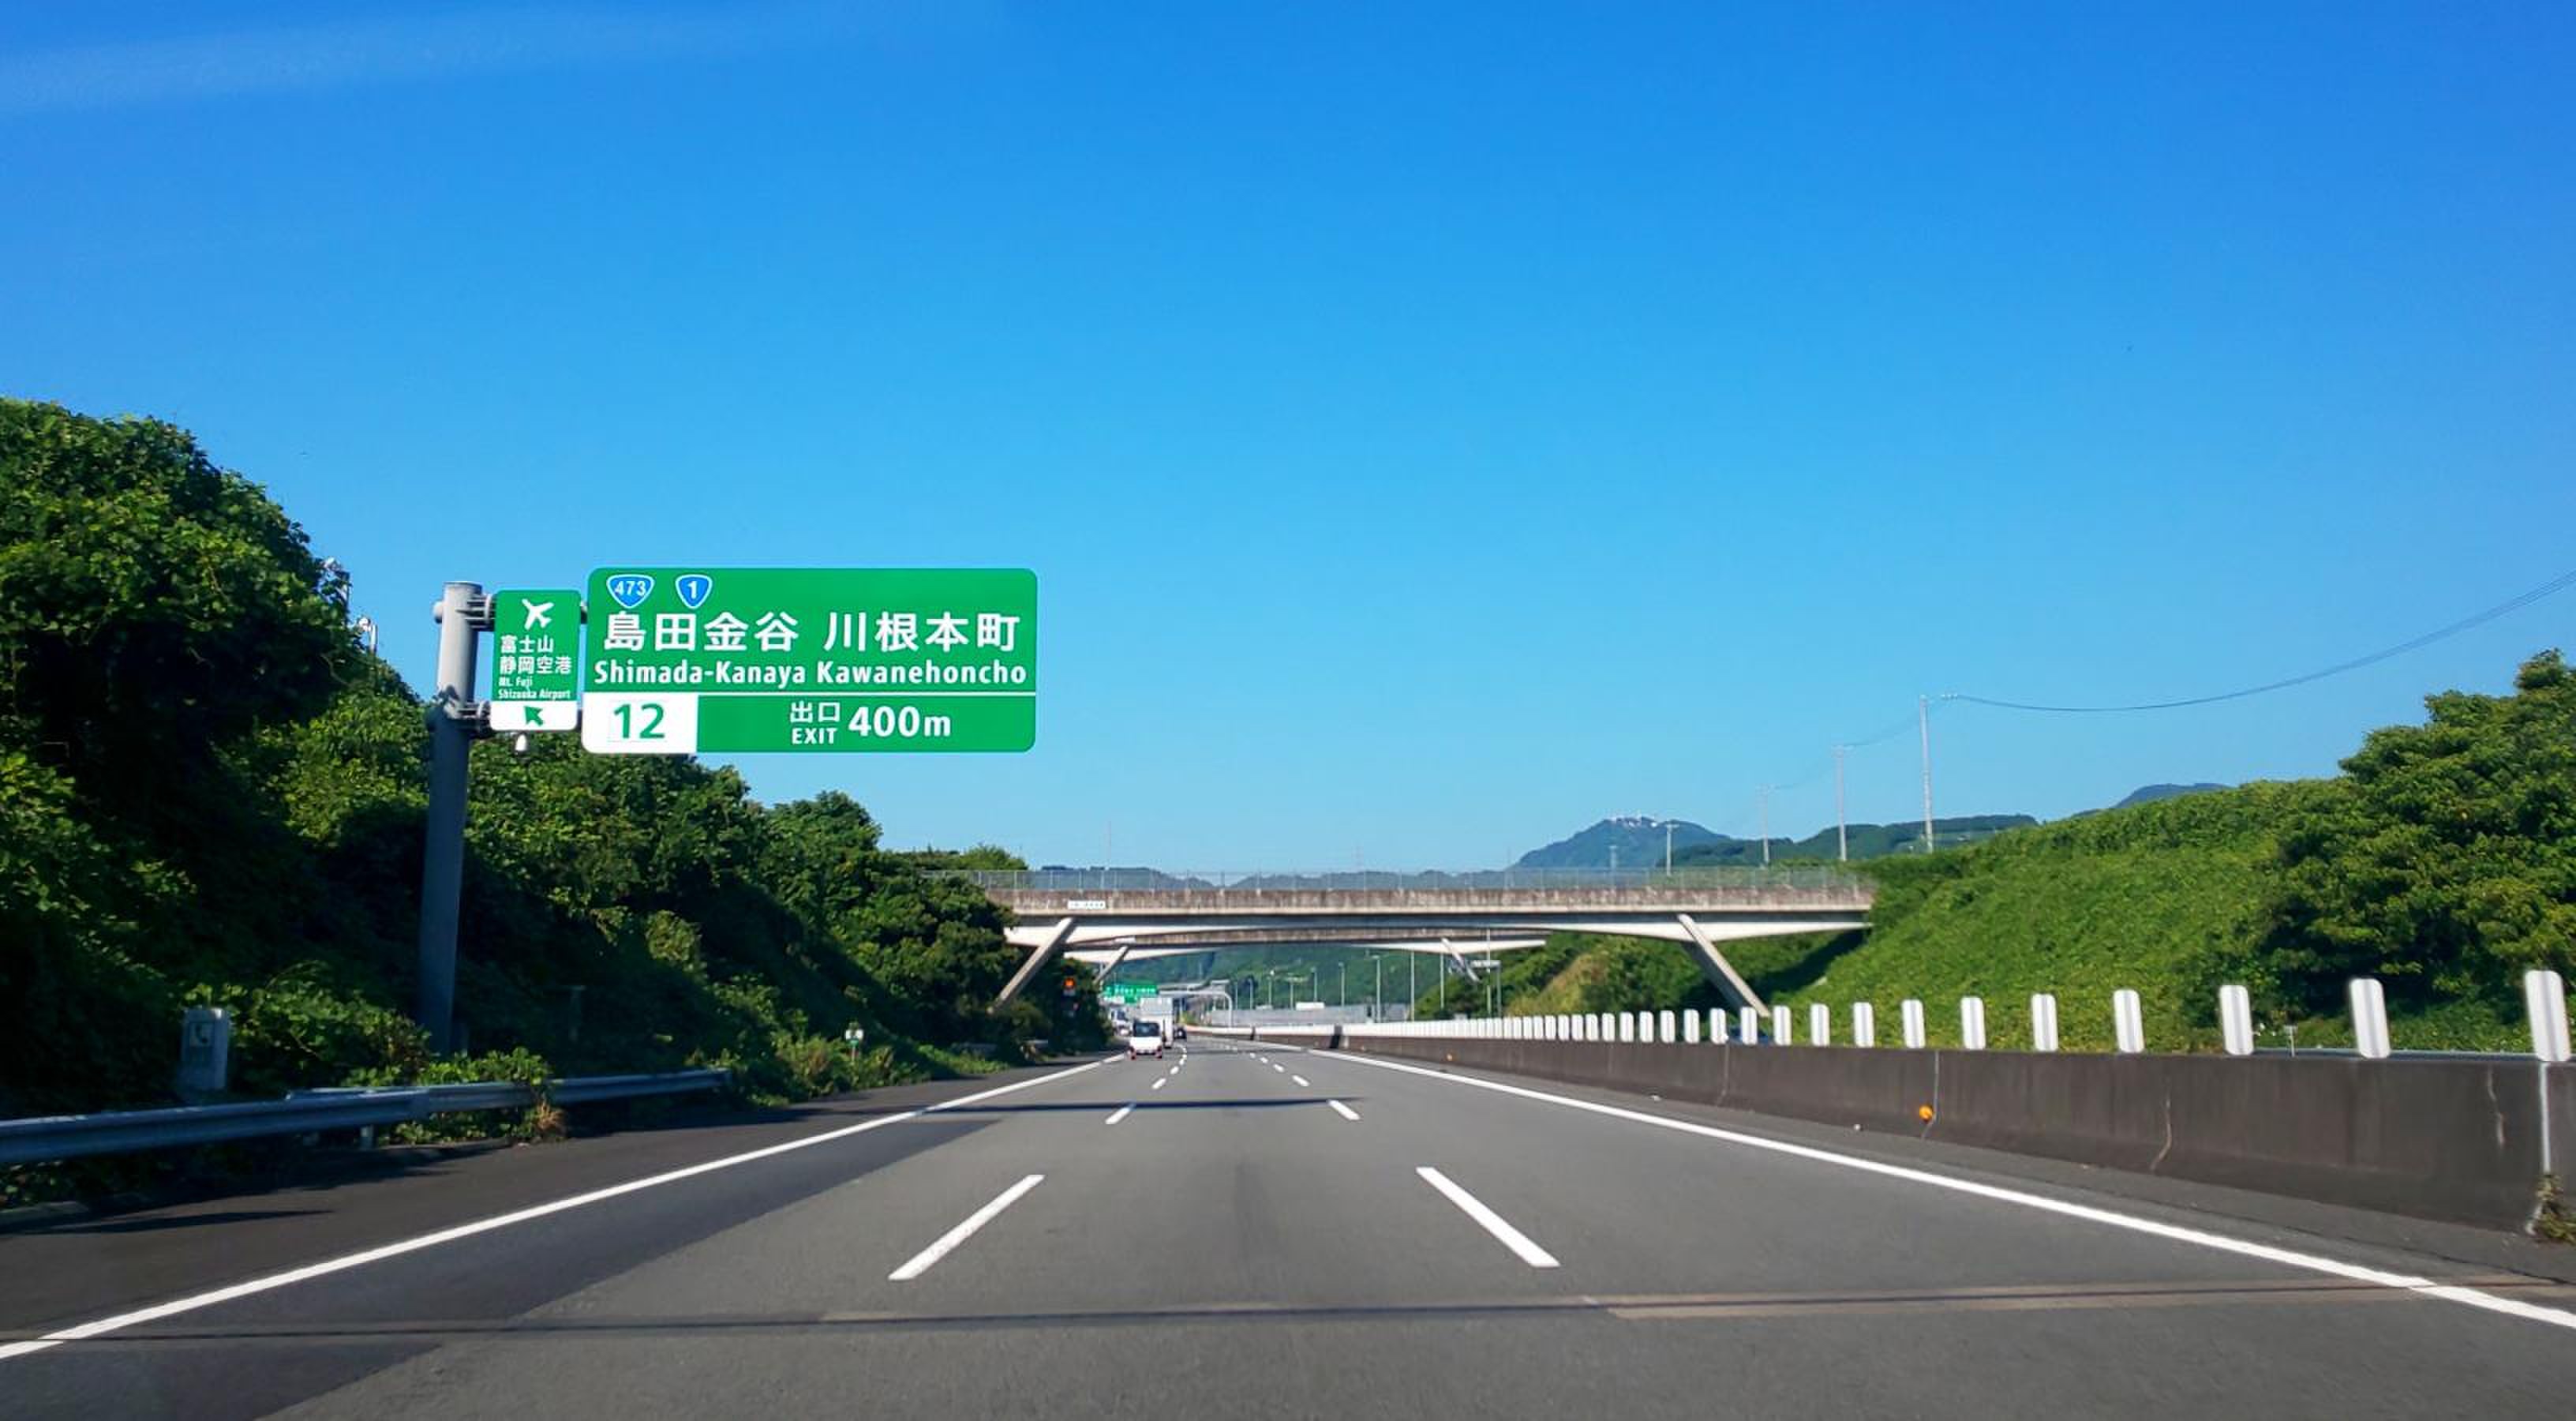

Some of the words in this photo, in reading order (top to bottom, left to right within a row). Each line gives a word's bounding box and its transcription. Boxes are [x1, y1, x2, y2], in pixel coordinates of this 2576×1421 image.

[615, 580, 646, 595] 473
[688, 580, 698, 598] 1
[605, 611, 798, 651] 島田金谷
[825, 611, 1019, 651] 川根本町
[500, 635, 554, 654] 富士山
[500, 656, 571, 675] 静岡空港
[594, 659, 805, 688] Shimada-Kanaya
[817, 659, 1027, 684] Kawanehoncho
[515, 677, 533, 689] Fuji
[498, 689, 537, 699] Shizuoka
[539, 689, 571, 700] Airport
[613, 703, 665, 739] 12
[790, 701, 841, 723] 出口
[849, 707, 950, 737] 400m
[792, 728, 837, 744] EXIT
